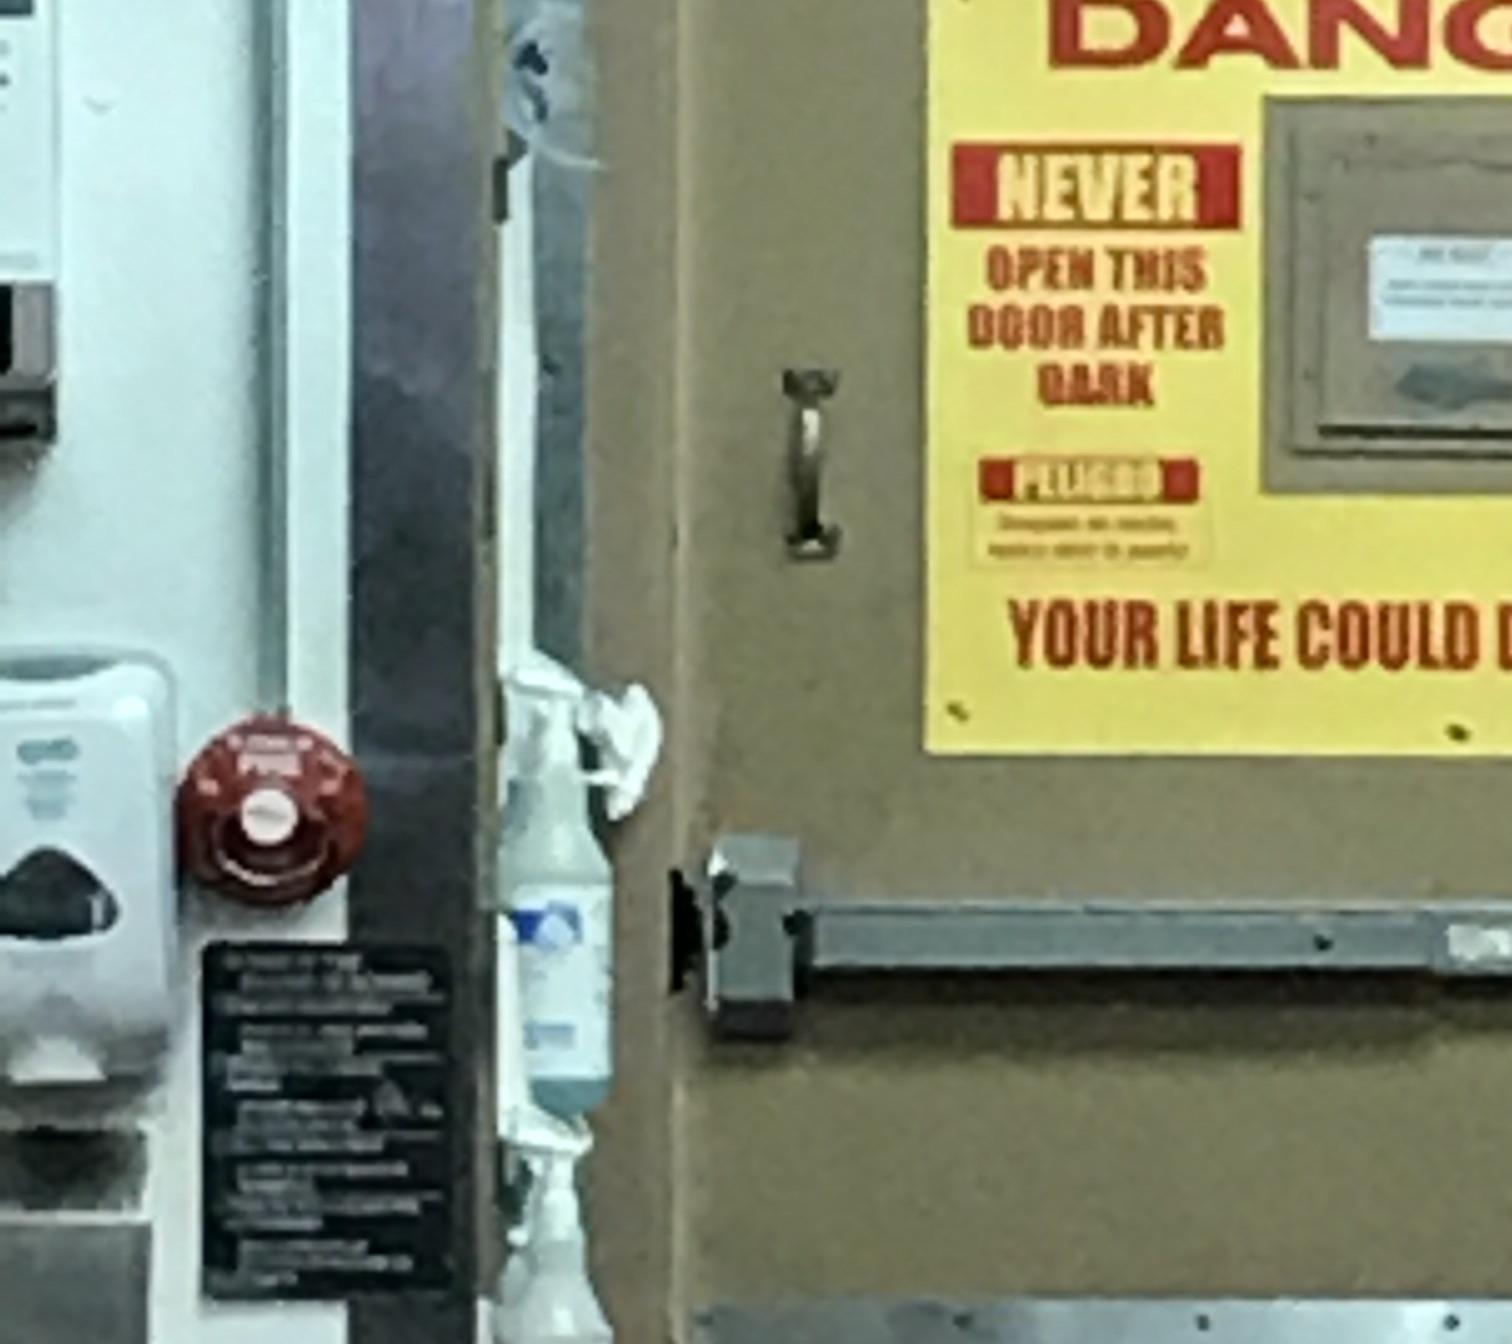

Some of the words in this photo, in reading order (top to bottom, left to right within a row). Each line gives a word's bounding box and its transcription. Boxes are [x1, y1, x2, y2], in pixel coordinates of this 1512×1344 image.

[997, 153, 1198, 222] NEVER
[986, 246, 1094, 290] OPEN
[1105, 246, 1206, 290] THIS
[967, 304, 1084, 349] DOOR
[1099, 304, 1225, 349] AFTER
[1037, 363, 1154, 408] DARK
[1006, 598, 1159, 670] YOUR
[1175, 599, 1281, 672] LIFE
[1297, 600, 1482, 672] COULD
